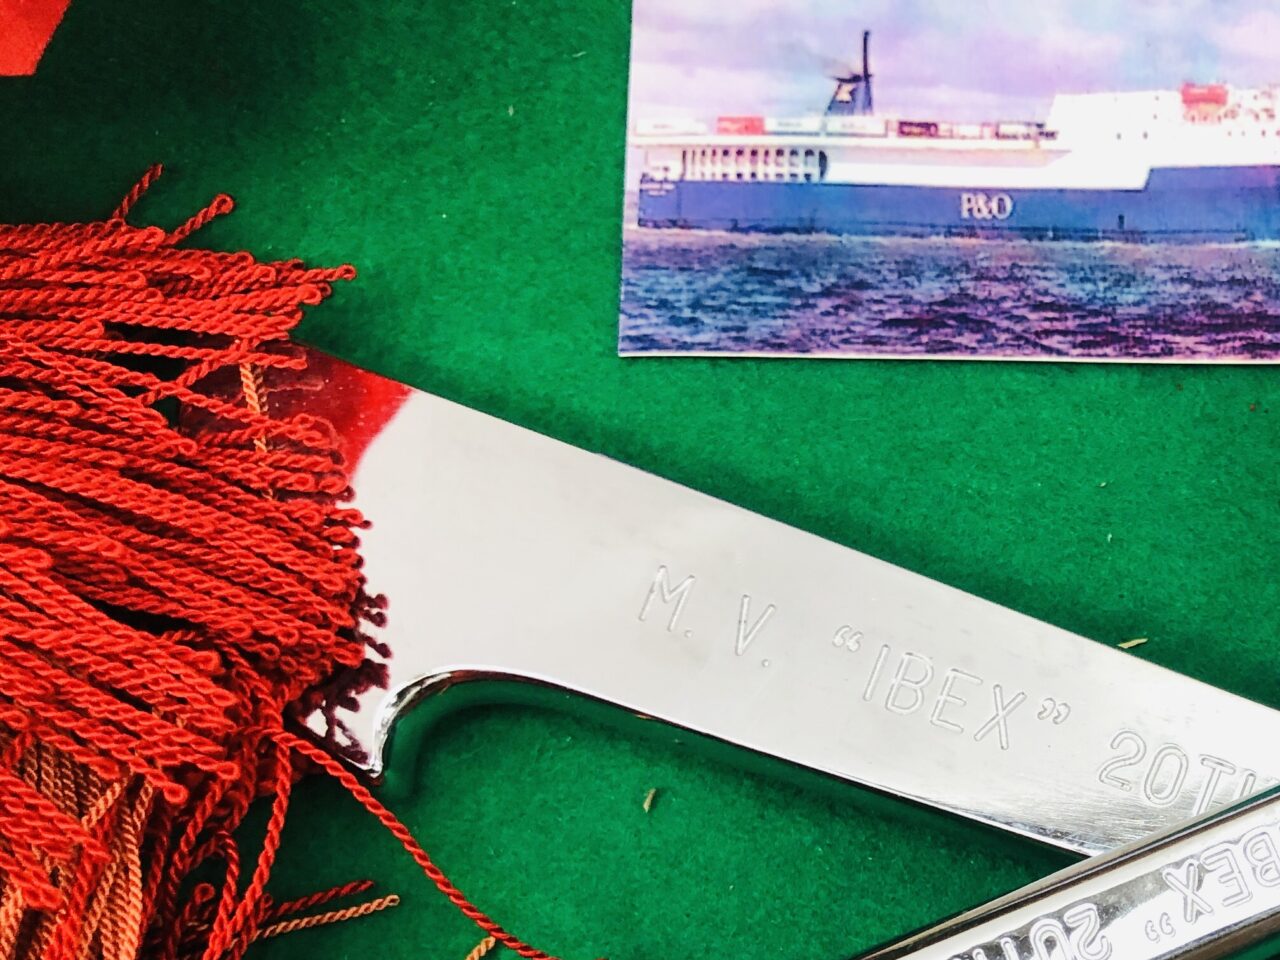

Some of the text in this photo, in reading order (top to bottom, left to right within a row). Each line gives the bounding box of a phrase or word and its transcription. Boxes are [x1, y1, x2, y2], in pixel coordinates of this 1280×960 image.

[961, 192, 1013, 219] P&O
[637, 564, 696, 638] M.
[735, 594, 777, 668] V.
